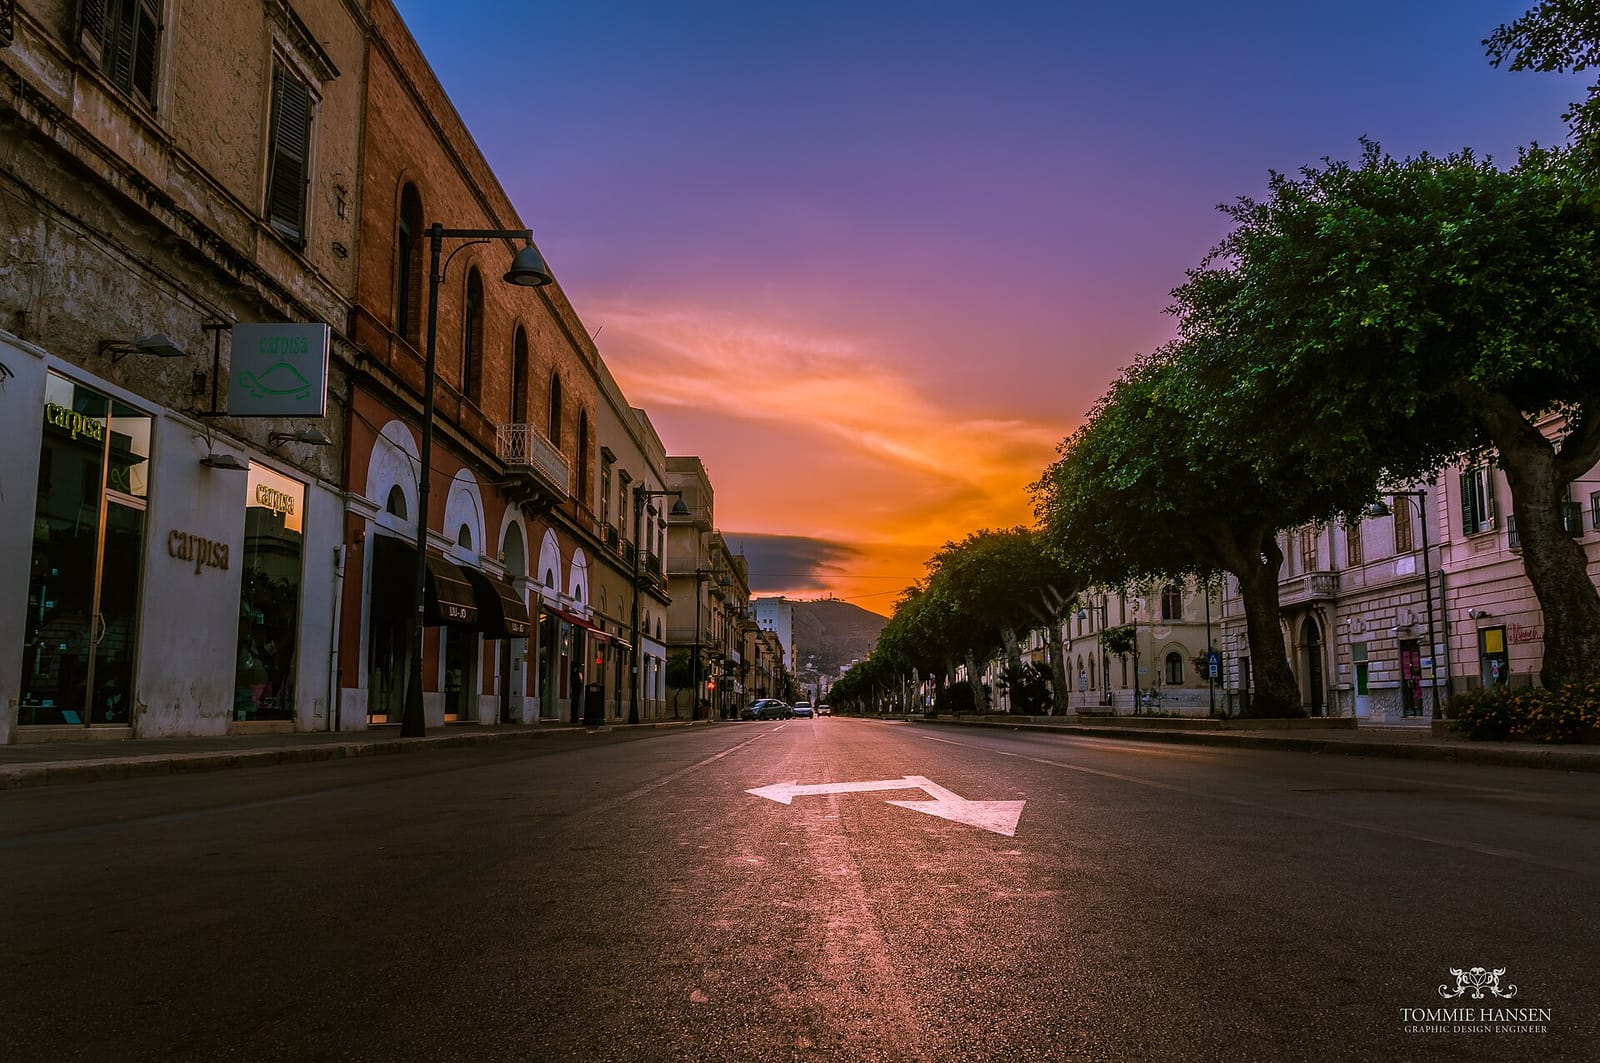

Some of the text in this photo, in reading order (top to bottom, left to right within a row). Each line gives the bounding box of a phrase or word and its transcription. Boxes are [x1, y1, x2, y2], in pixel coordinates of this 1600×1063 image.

[258, 335, 309, 361] carpisa
[46, 402, 102, 440] carpisa
[256, 483, 295, 517] carpisa
[167, 529, 229, 575] carpisa
